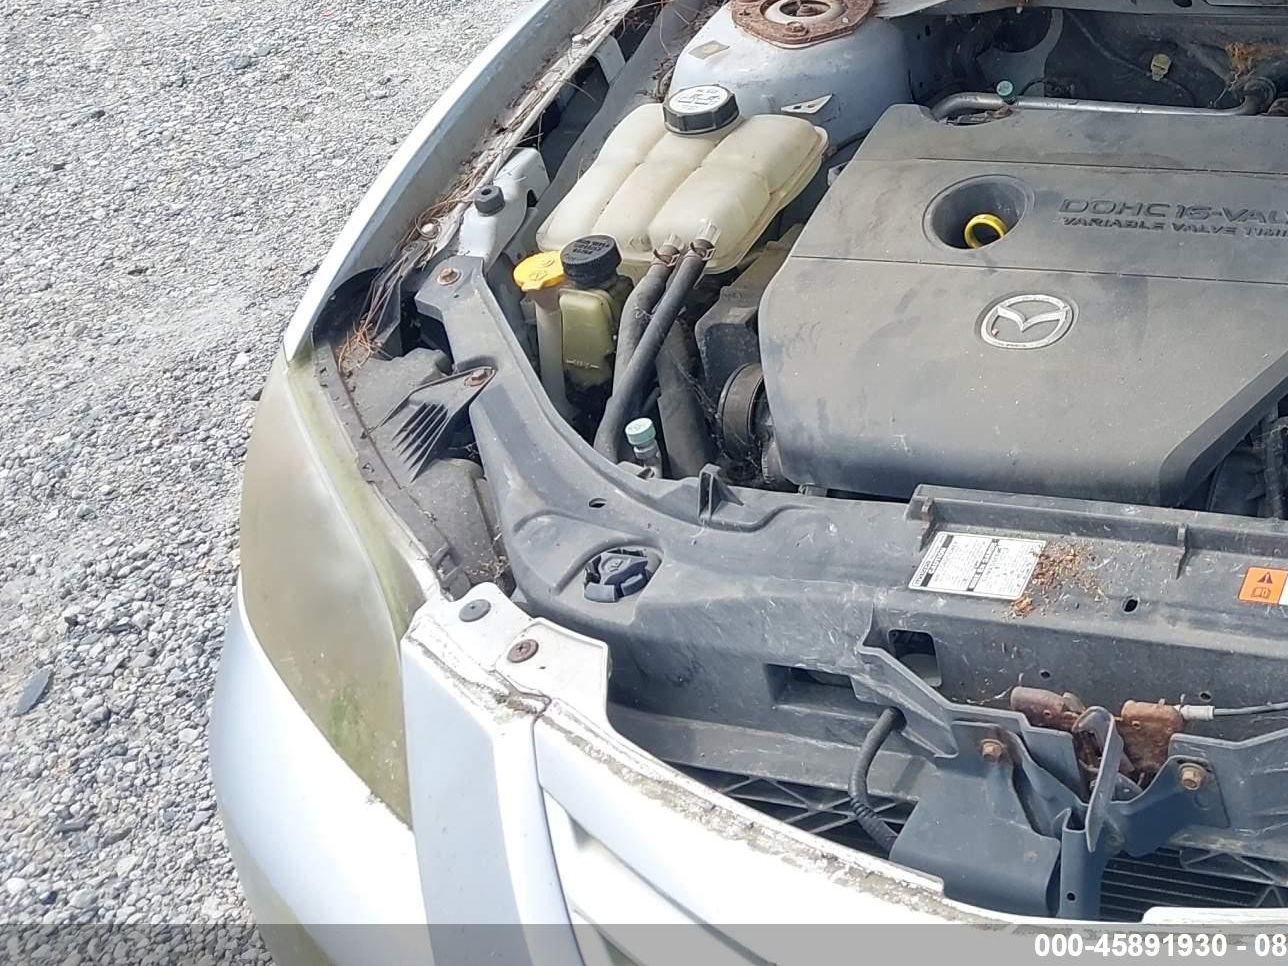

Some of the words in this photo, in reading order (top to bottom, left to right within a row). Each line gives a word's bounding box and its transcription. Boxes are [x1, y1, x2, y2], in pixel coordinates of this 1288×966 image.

[1058, 198, 1171, 218] DOHC
[1062, 216, 1165, 231] VARIABLE
[1171, 222, 1238, 235] VALVE
